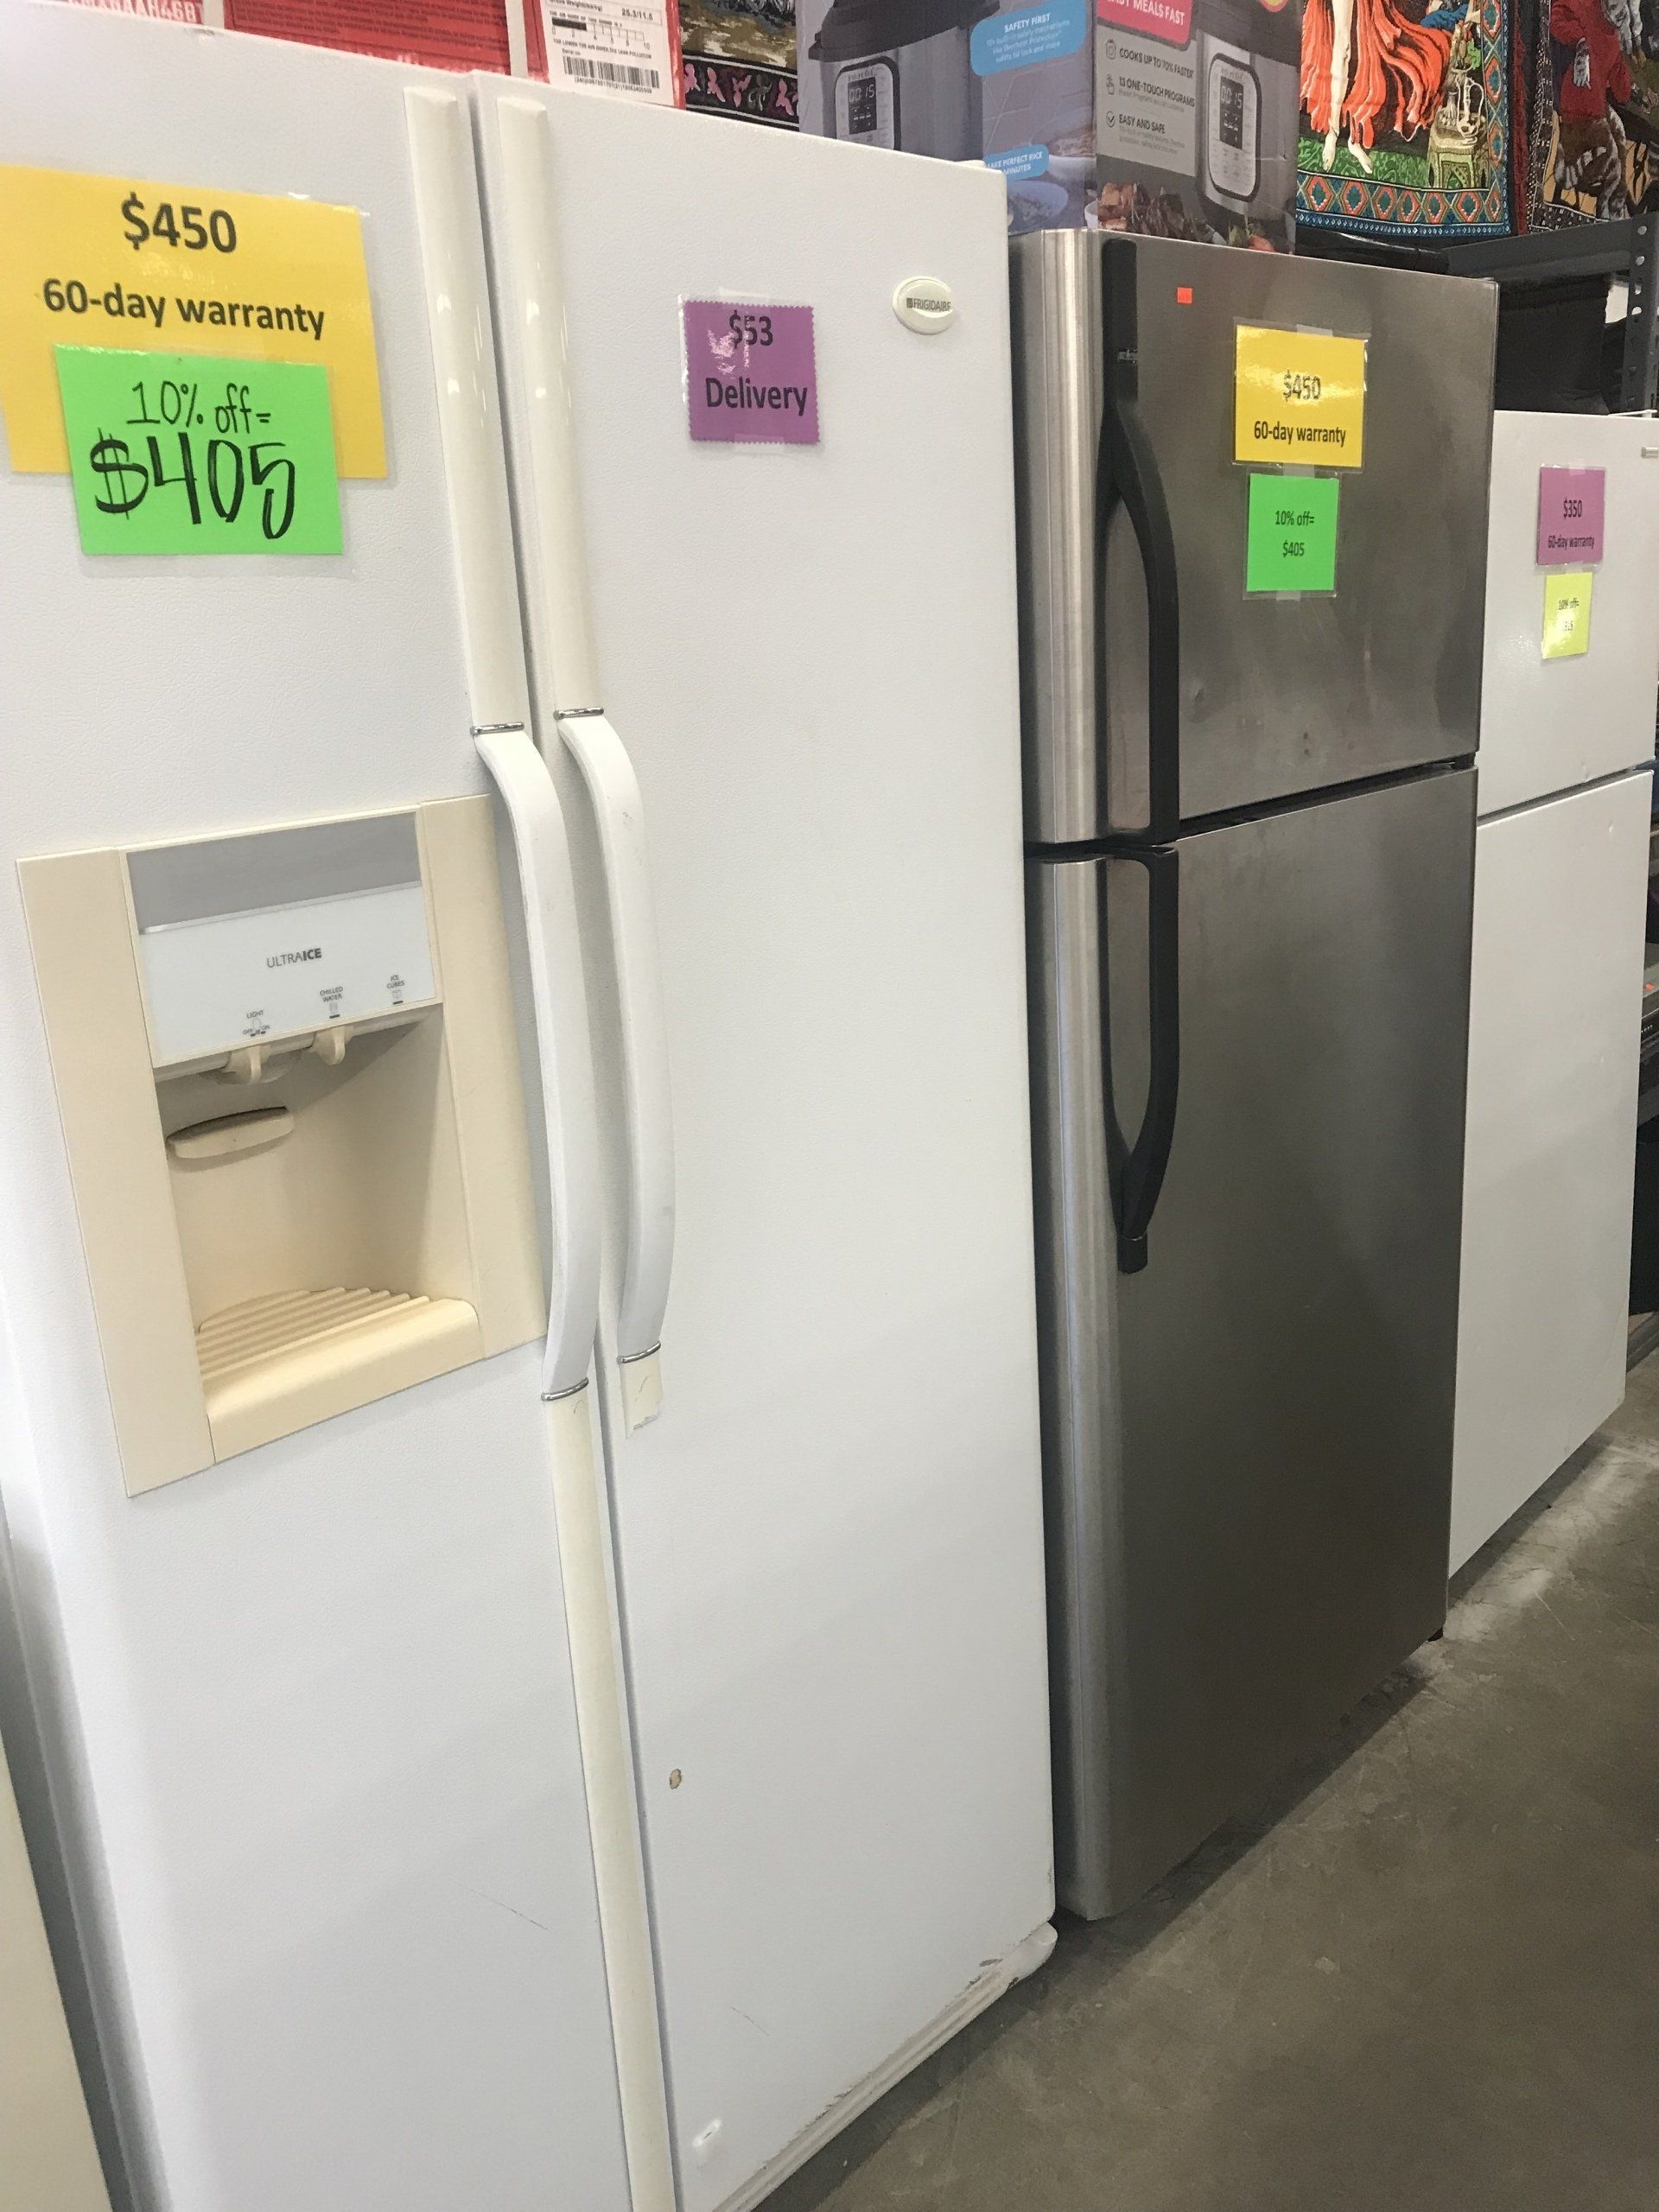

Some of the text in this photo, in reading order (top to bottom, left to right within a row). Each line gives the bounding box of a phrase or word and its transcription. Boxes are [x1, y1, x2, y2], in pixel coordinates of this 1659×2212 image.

[1004, 13, 1051, 33] SAFETY FIRST
[1134, 0, 1185, 26] MEALS FAST
[1120, 48, 1142, 63] COOKS
[1143, 54, 1153, 64] UP
[1153, 56, 1162, 68] TO
[1126, 78, 1164, 97] ONE-TOUCH
[1164, 88, 1195, 107] PROGRAMS
[1119, 114, 1166, 134] EASY AND SAFE
[1002, 154, 1028, 167] PERFECT
[1028, 151, 1043, 161] RICE
[121, 192, 237, 253] $450
[43, 278, 325, 340] 60-day warranty
[912, 298, 951, 311] FRIGIDAIRE
[728, 309, 773, 350] $53
[705, 376, 808, 416] Delivery
[1282, 370, 1322, 402] $450
[126, 380, 204, 428] 10%
[1254, 421, 1346, 447] 60-day warranty
[90, 428, 295, 539] $405
[1274, 511, 1294, 525] 10%
[1562, 498, 1583, 519] $350
[1282, 540, 1306, 558] $405
[1548, 534, 1595, 550] 60-day warranty
[266, 948, 322, 968] ULTRAICE
[386, 980, 405, 989] CUBES
[321, 993, 343, 1002] WATER
